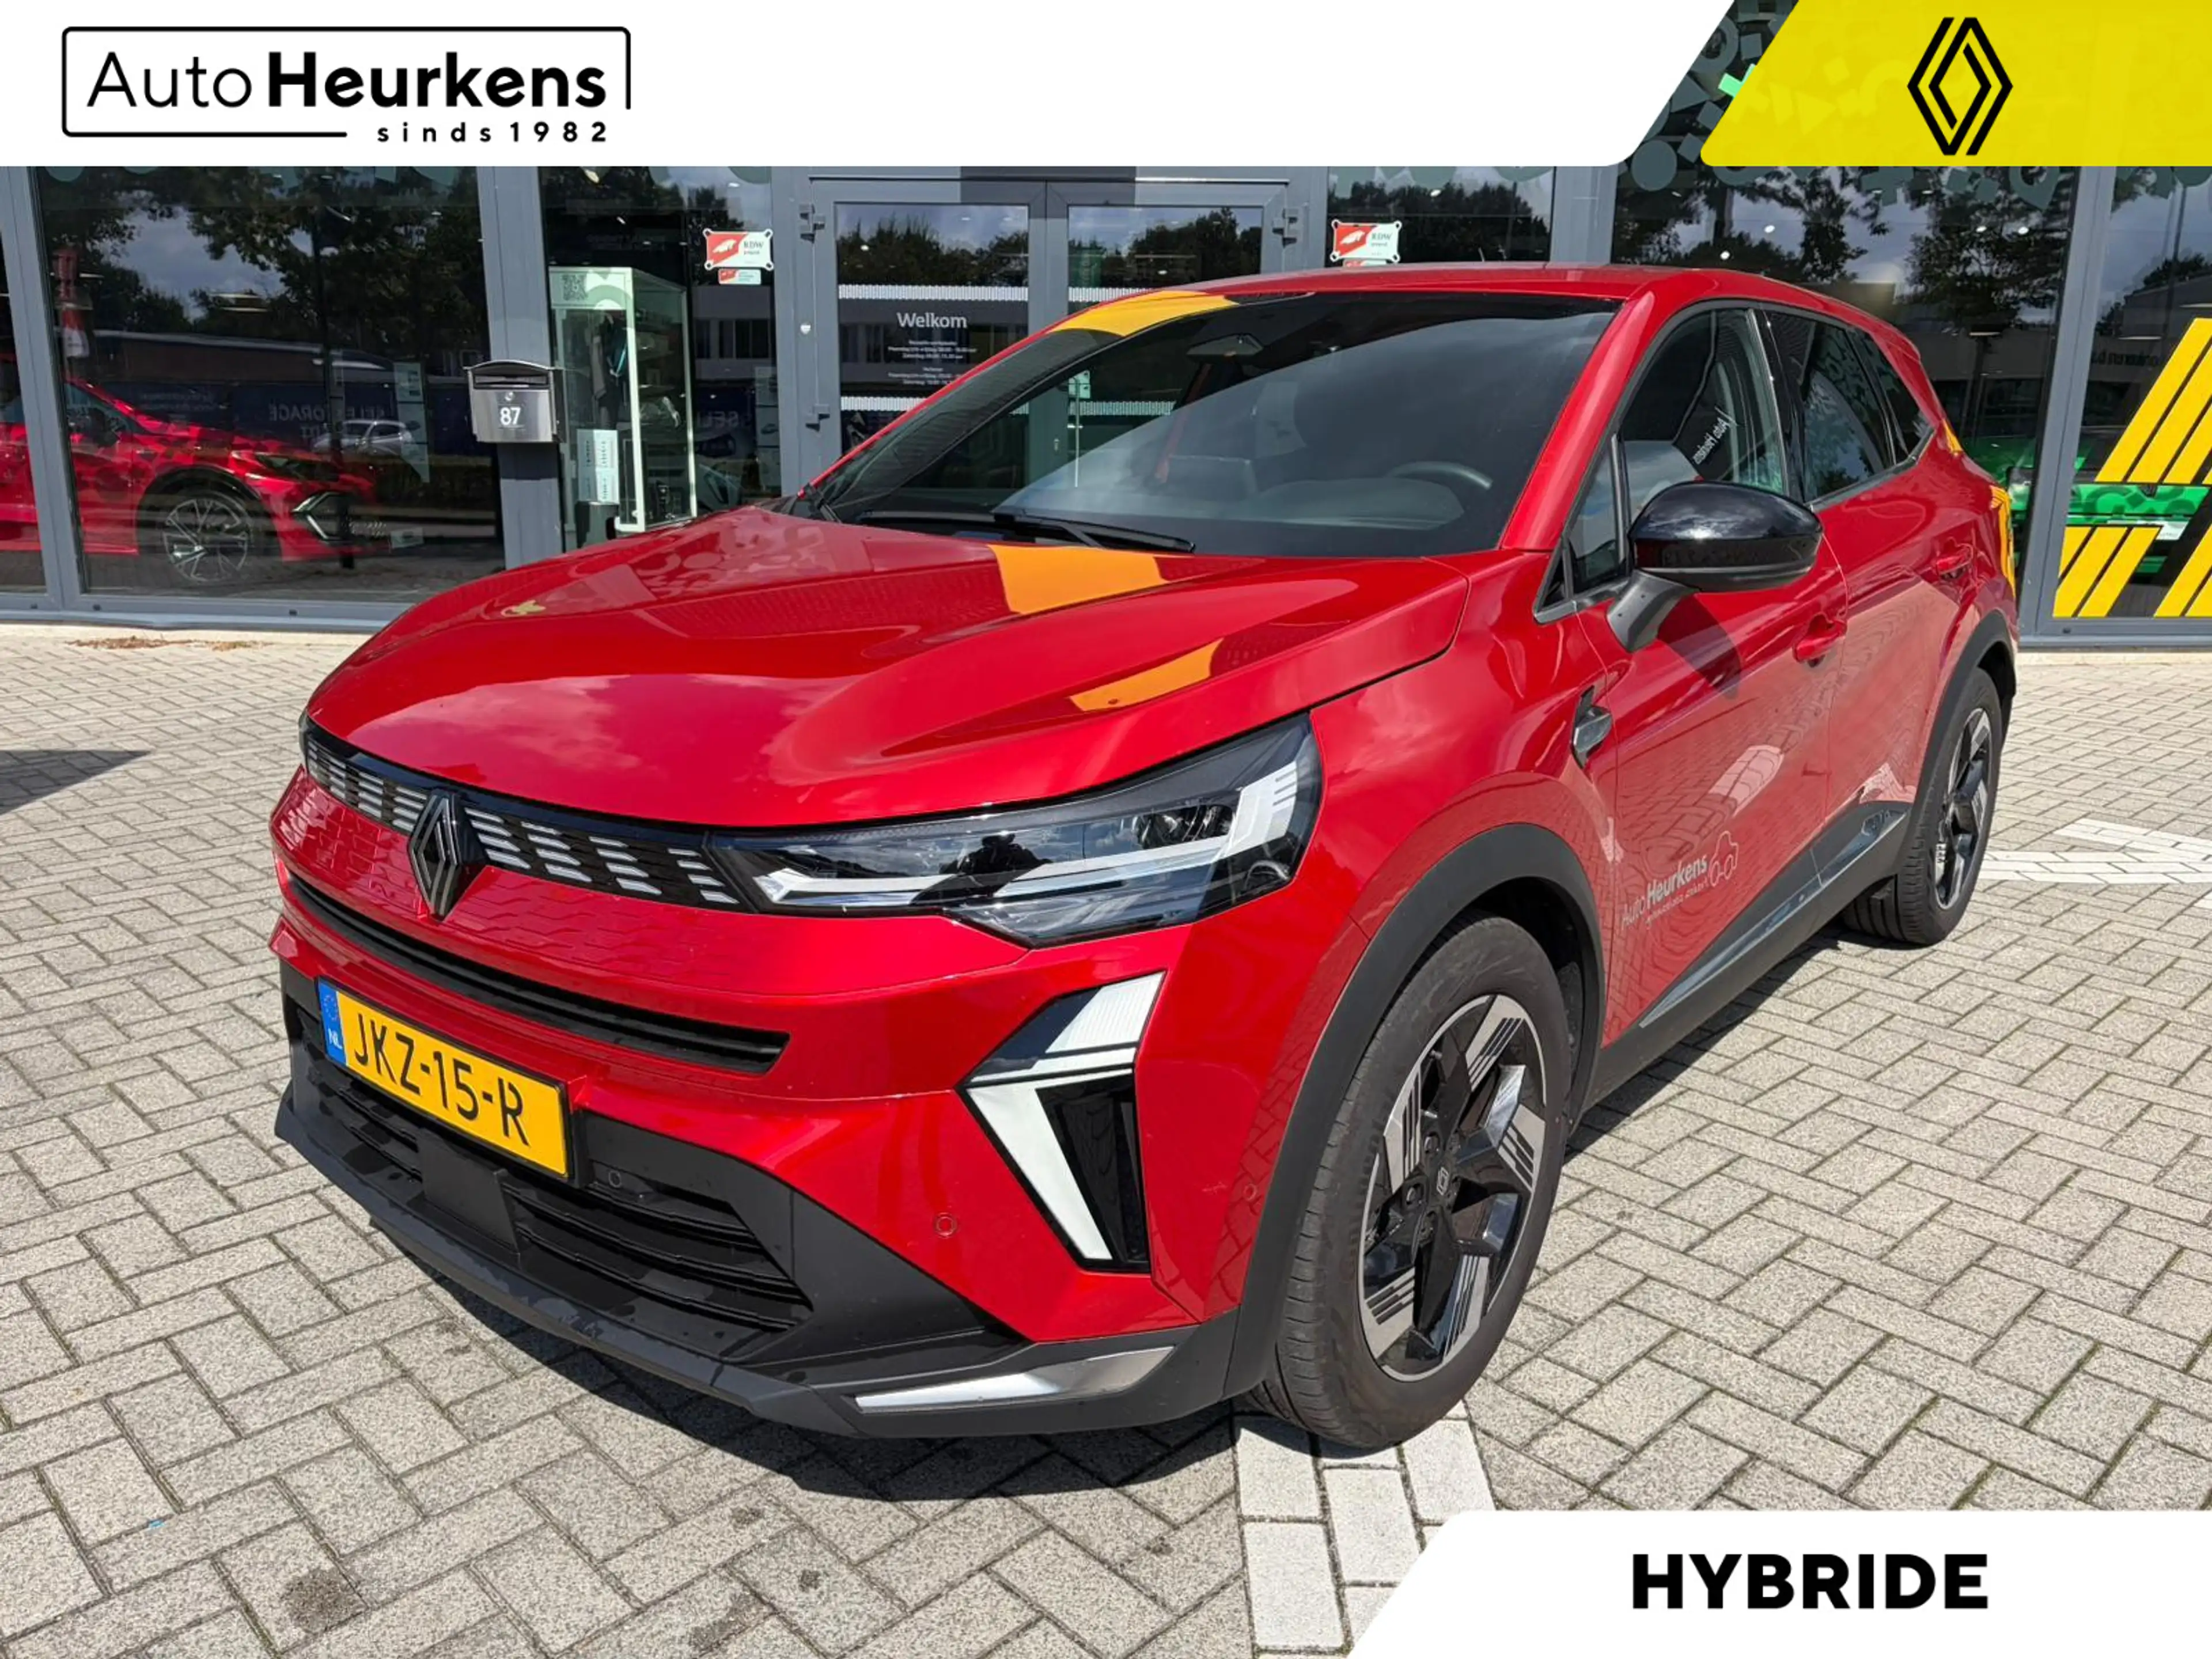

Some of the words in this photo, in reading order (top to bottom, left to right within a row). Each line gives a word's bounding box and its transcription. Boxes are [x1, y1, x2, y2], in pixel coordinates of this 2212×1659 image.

[896, 312, 968, 328] Welkom
[500, 407, 521, 425] 87
[1646, 854, 1708, 910] Heurkens
[328, 1028, 343, 1050] NL
[354, 1013, 532, 1147] JKZ-15-R
